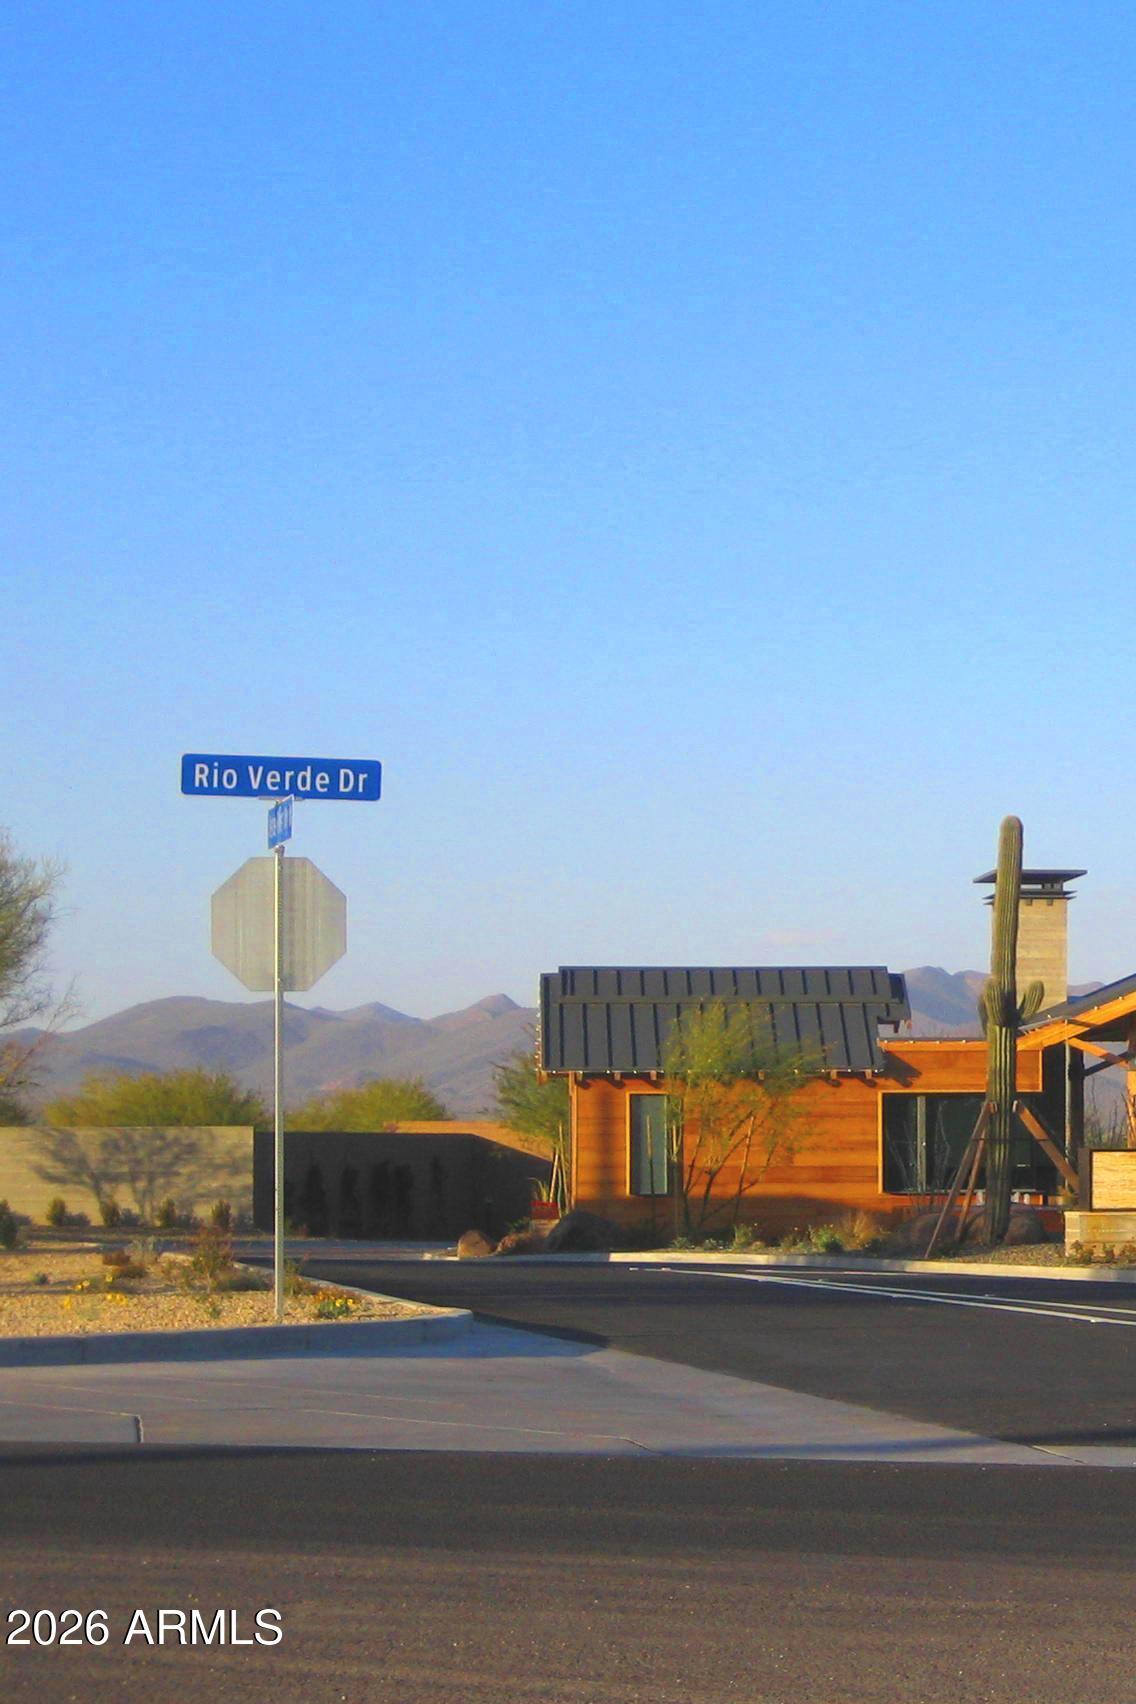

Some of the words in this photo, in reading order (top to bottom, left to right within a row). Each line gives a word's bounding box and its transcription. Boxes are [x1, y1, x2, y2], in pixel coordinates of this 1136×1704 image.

[194, 762, 238, 789] Rio
[248, 765, 330, 792] Verde
[338, 768, 369, 793] Dr
